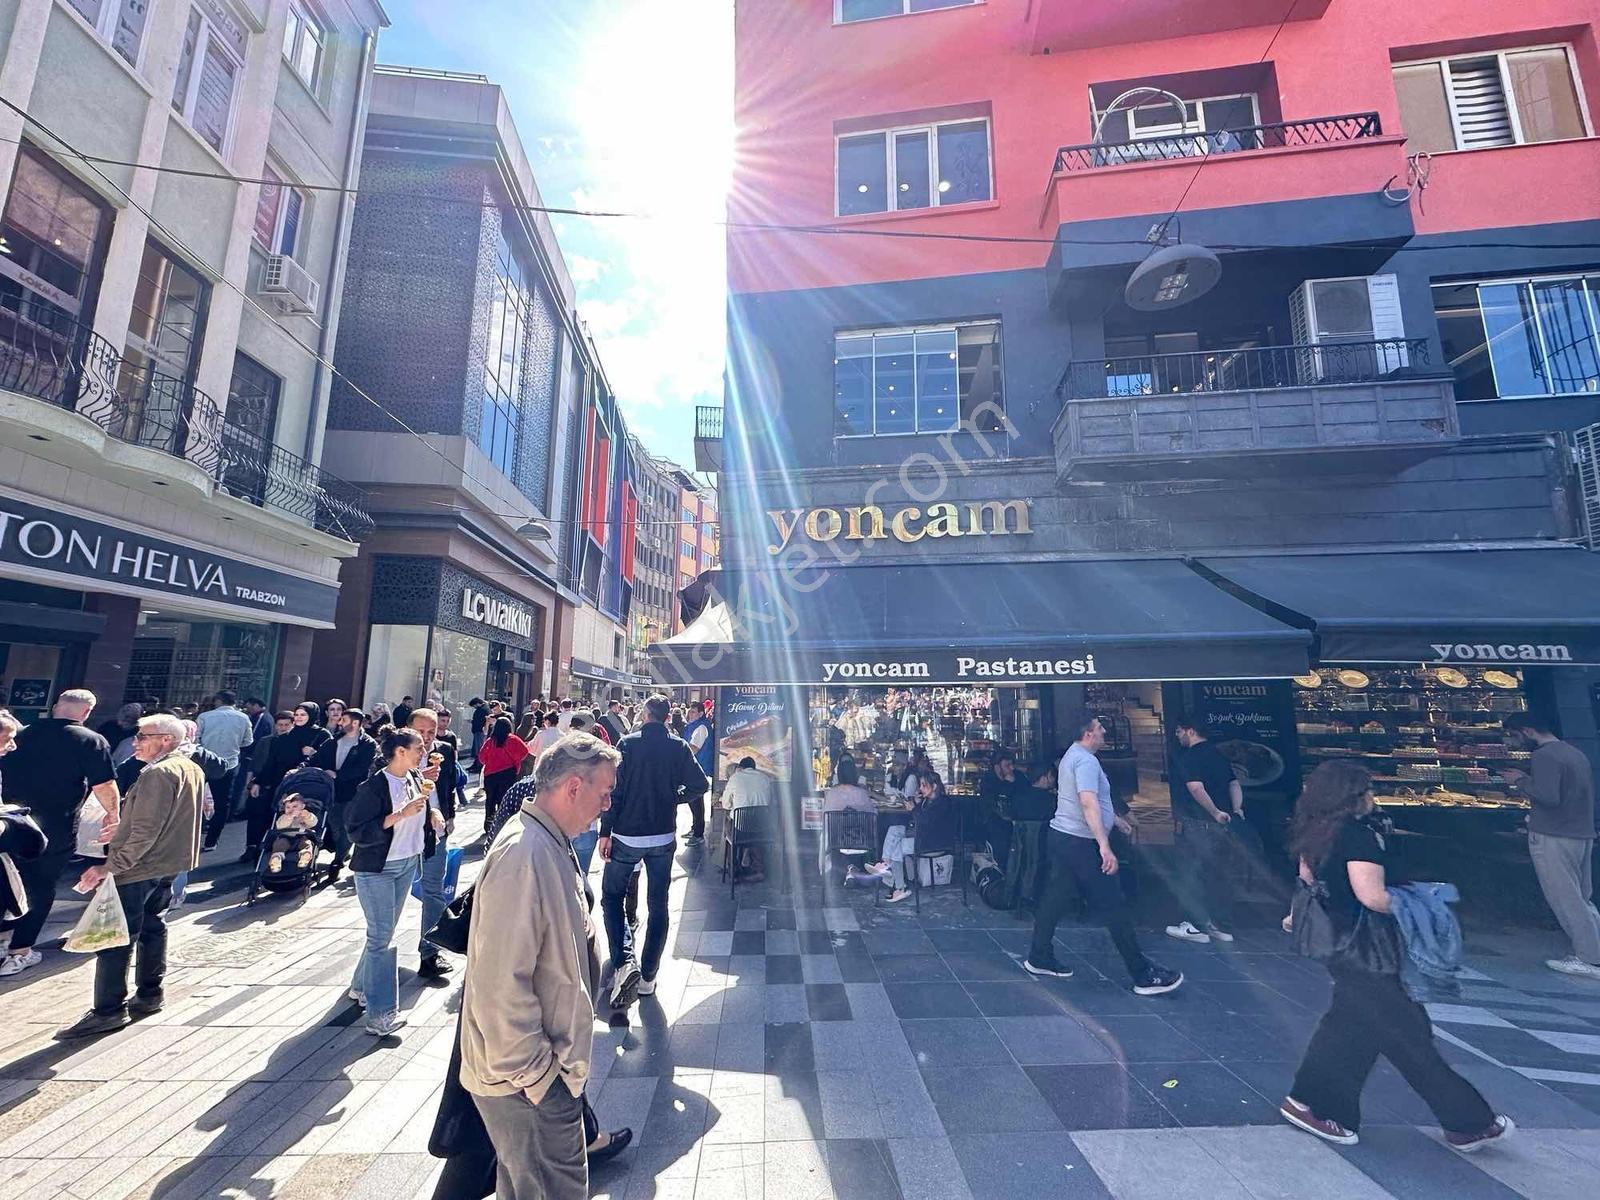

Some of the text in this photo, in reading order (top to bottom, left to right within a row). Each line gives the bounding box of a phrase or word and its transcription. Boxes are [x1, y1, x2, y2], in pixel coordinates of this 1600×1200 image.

[766, 499, 1034, 555] yoncam
[112, 541, 228, 596] HELVA
[236, 586, 286, 606] TRABZON
[1430, 642, 1573, 662] yoncam
[822, 654, 1096, 682] yoncam Pastanesi
[735, 685, 776, 697] yoncam
[1203, 685, 1267, 699] yoncam
